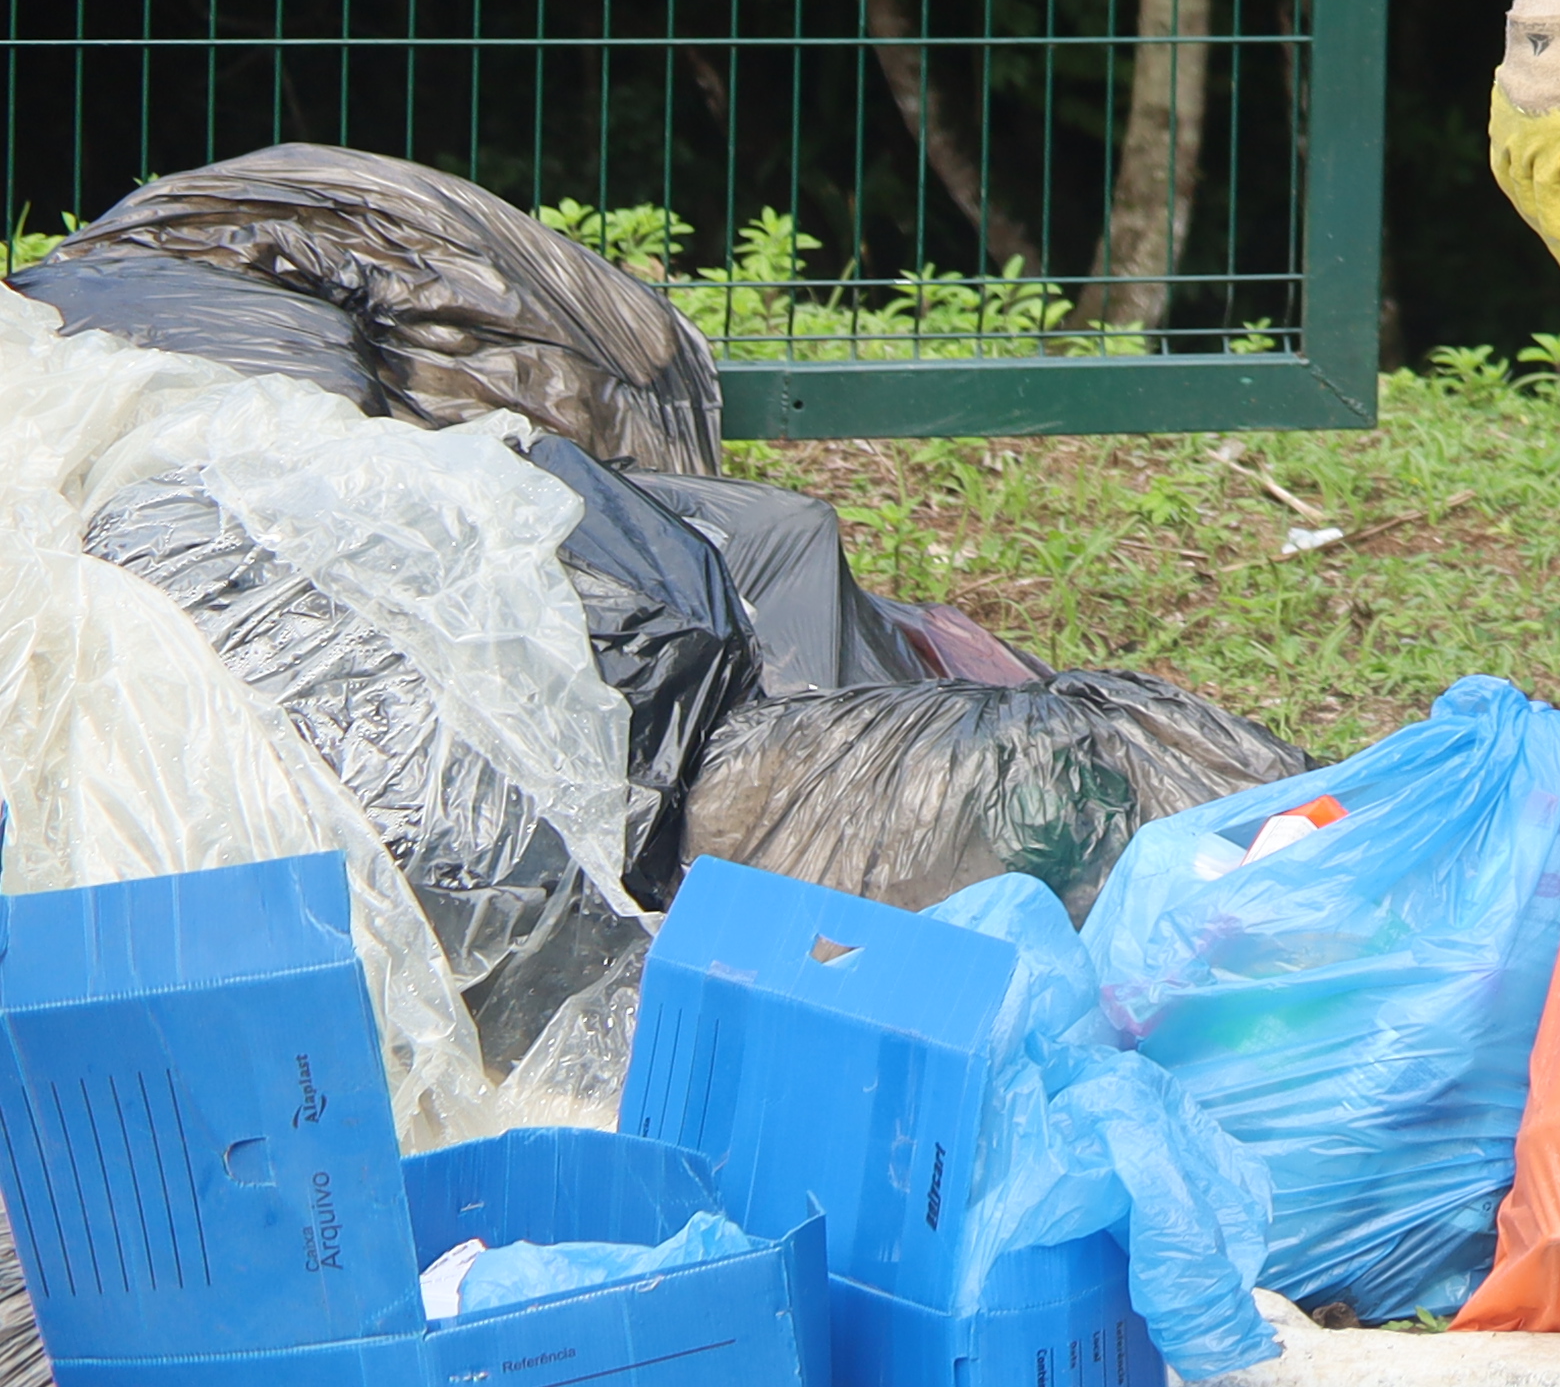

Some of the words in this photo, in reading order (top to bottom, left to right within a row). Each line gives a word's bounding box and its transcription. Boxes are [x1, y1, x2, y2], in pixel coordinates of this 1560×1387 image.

[296, 1054, 320, 1124] Alaplast
[305, 1226, 320, 1273] Caixa
[312, 1171, 344, 1271] Arquivo
[502, 1346, 578, 1375] Referência
